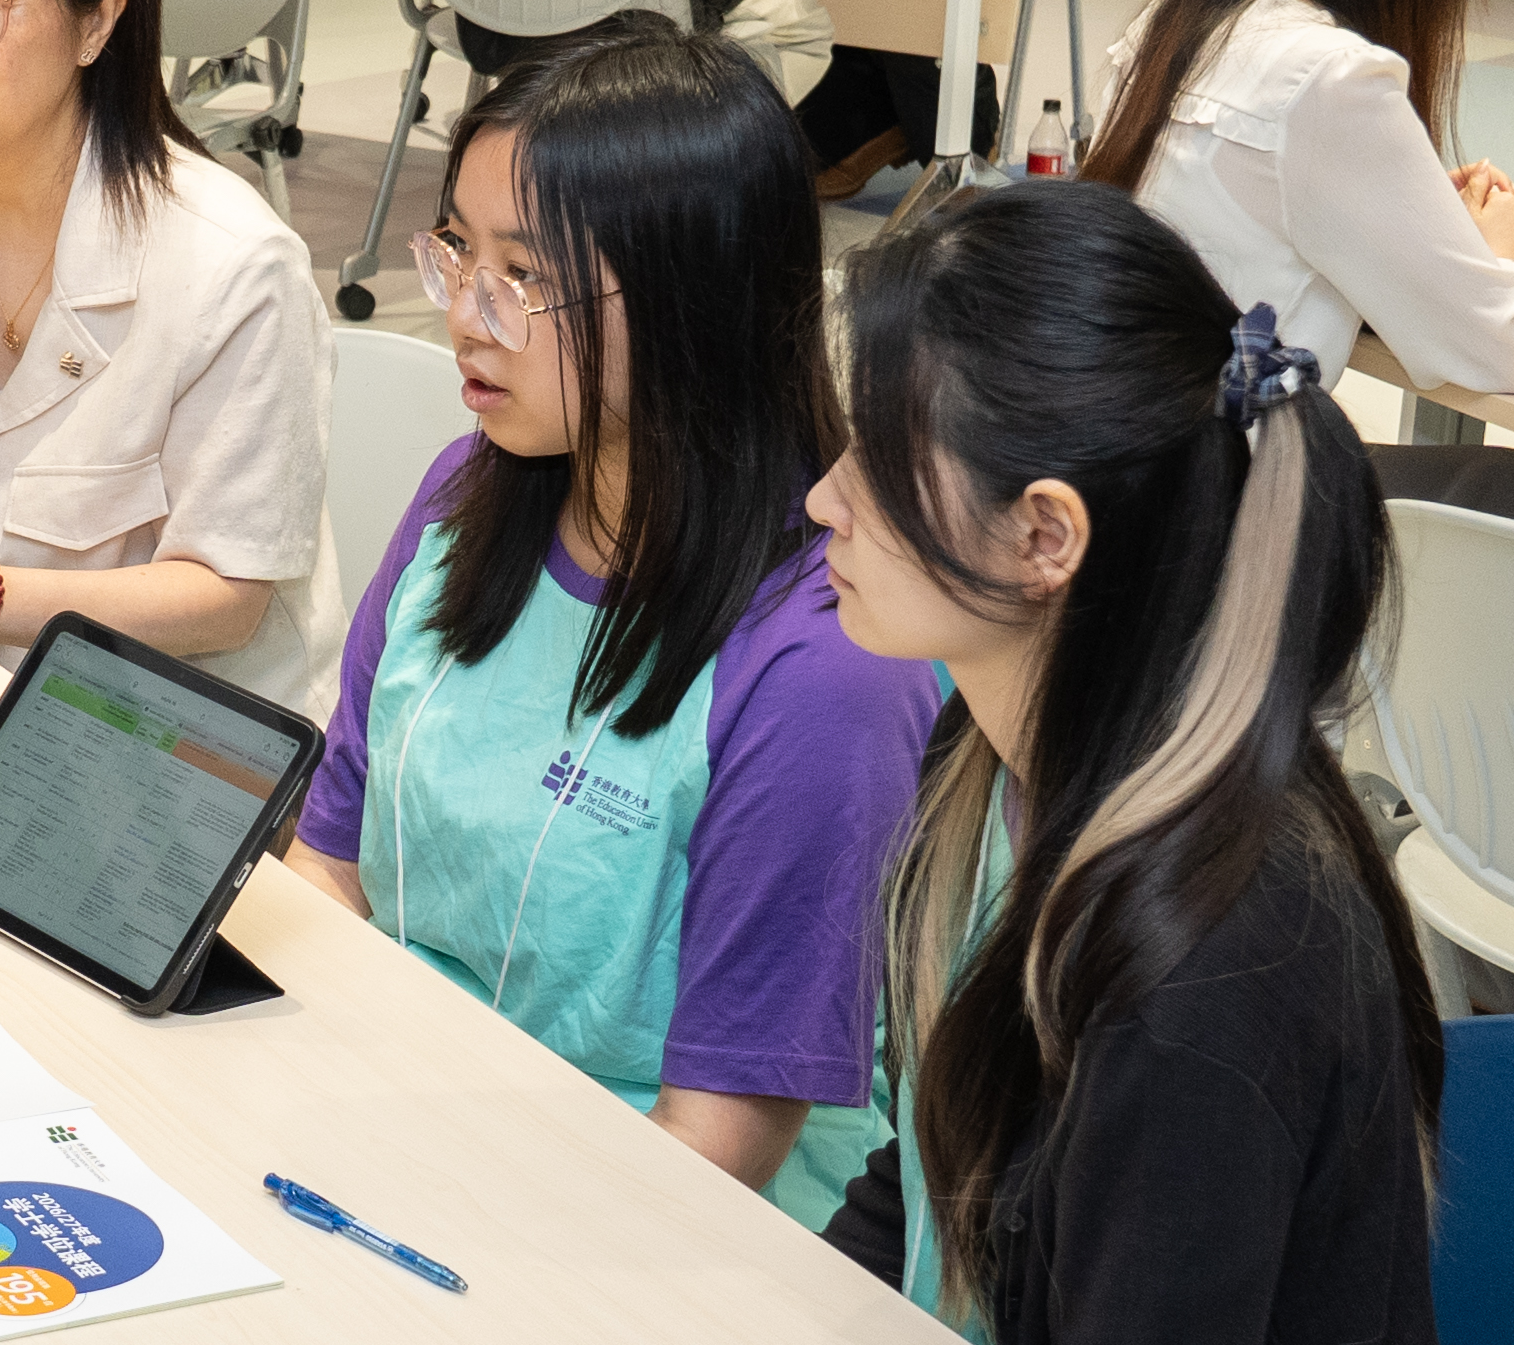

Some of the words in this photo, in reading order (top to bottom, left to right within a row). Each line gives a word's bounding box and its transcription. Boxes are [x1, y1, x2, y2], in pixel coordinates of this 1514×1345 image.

[575, 803, 586, 814] of
[585, 806, 606, 827] Hong
[606, 817, 630, 836] Kong
[582, 791, 598, 805] The
[598, 798, 636, 824] Education
[2, 1198, 106, 1278] 学士学位课程
[32, 1192, 102, 1247] 2026/27年度
